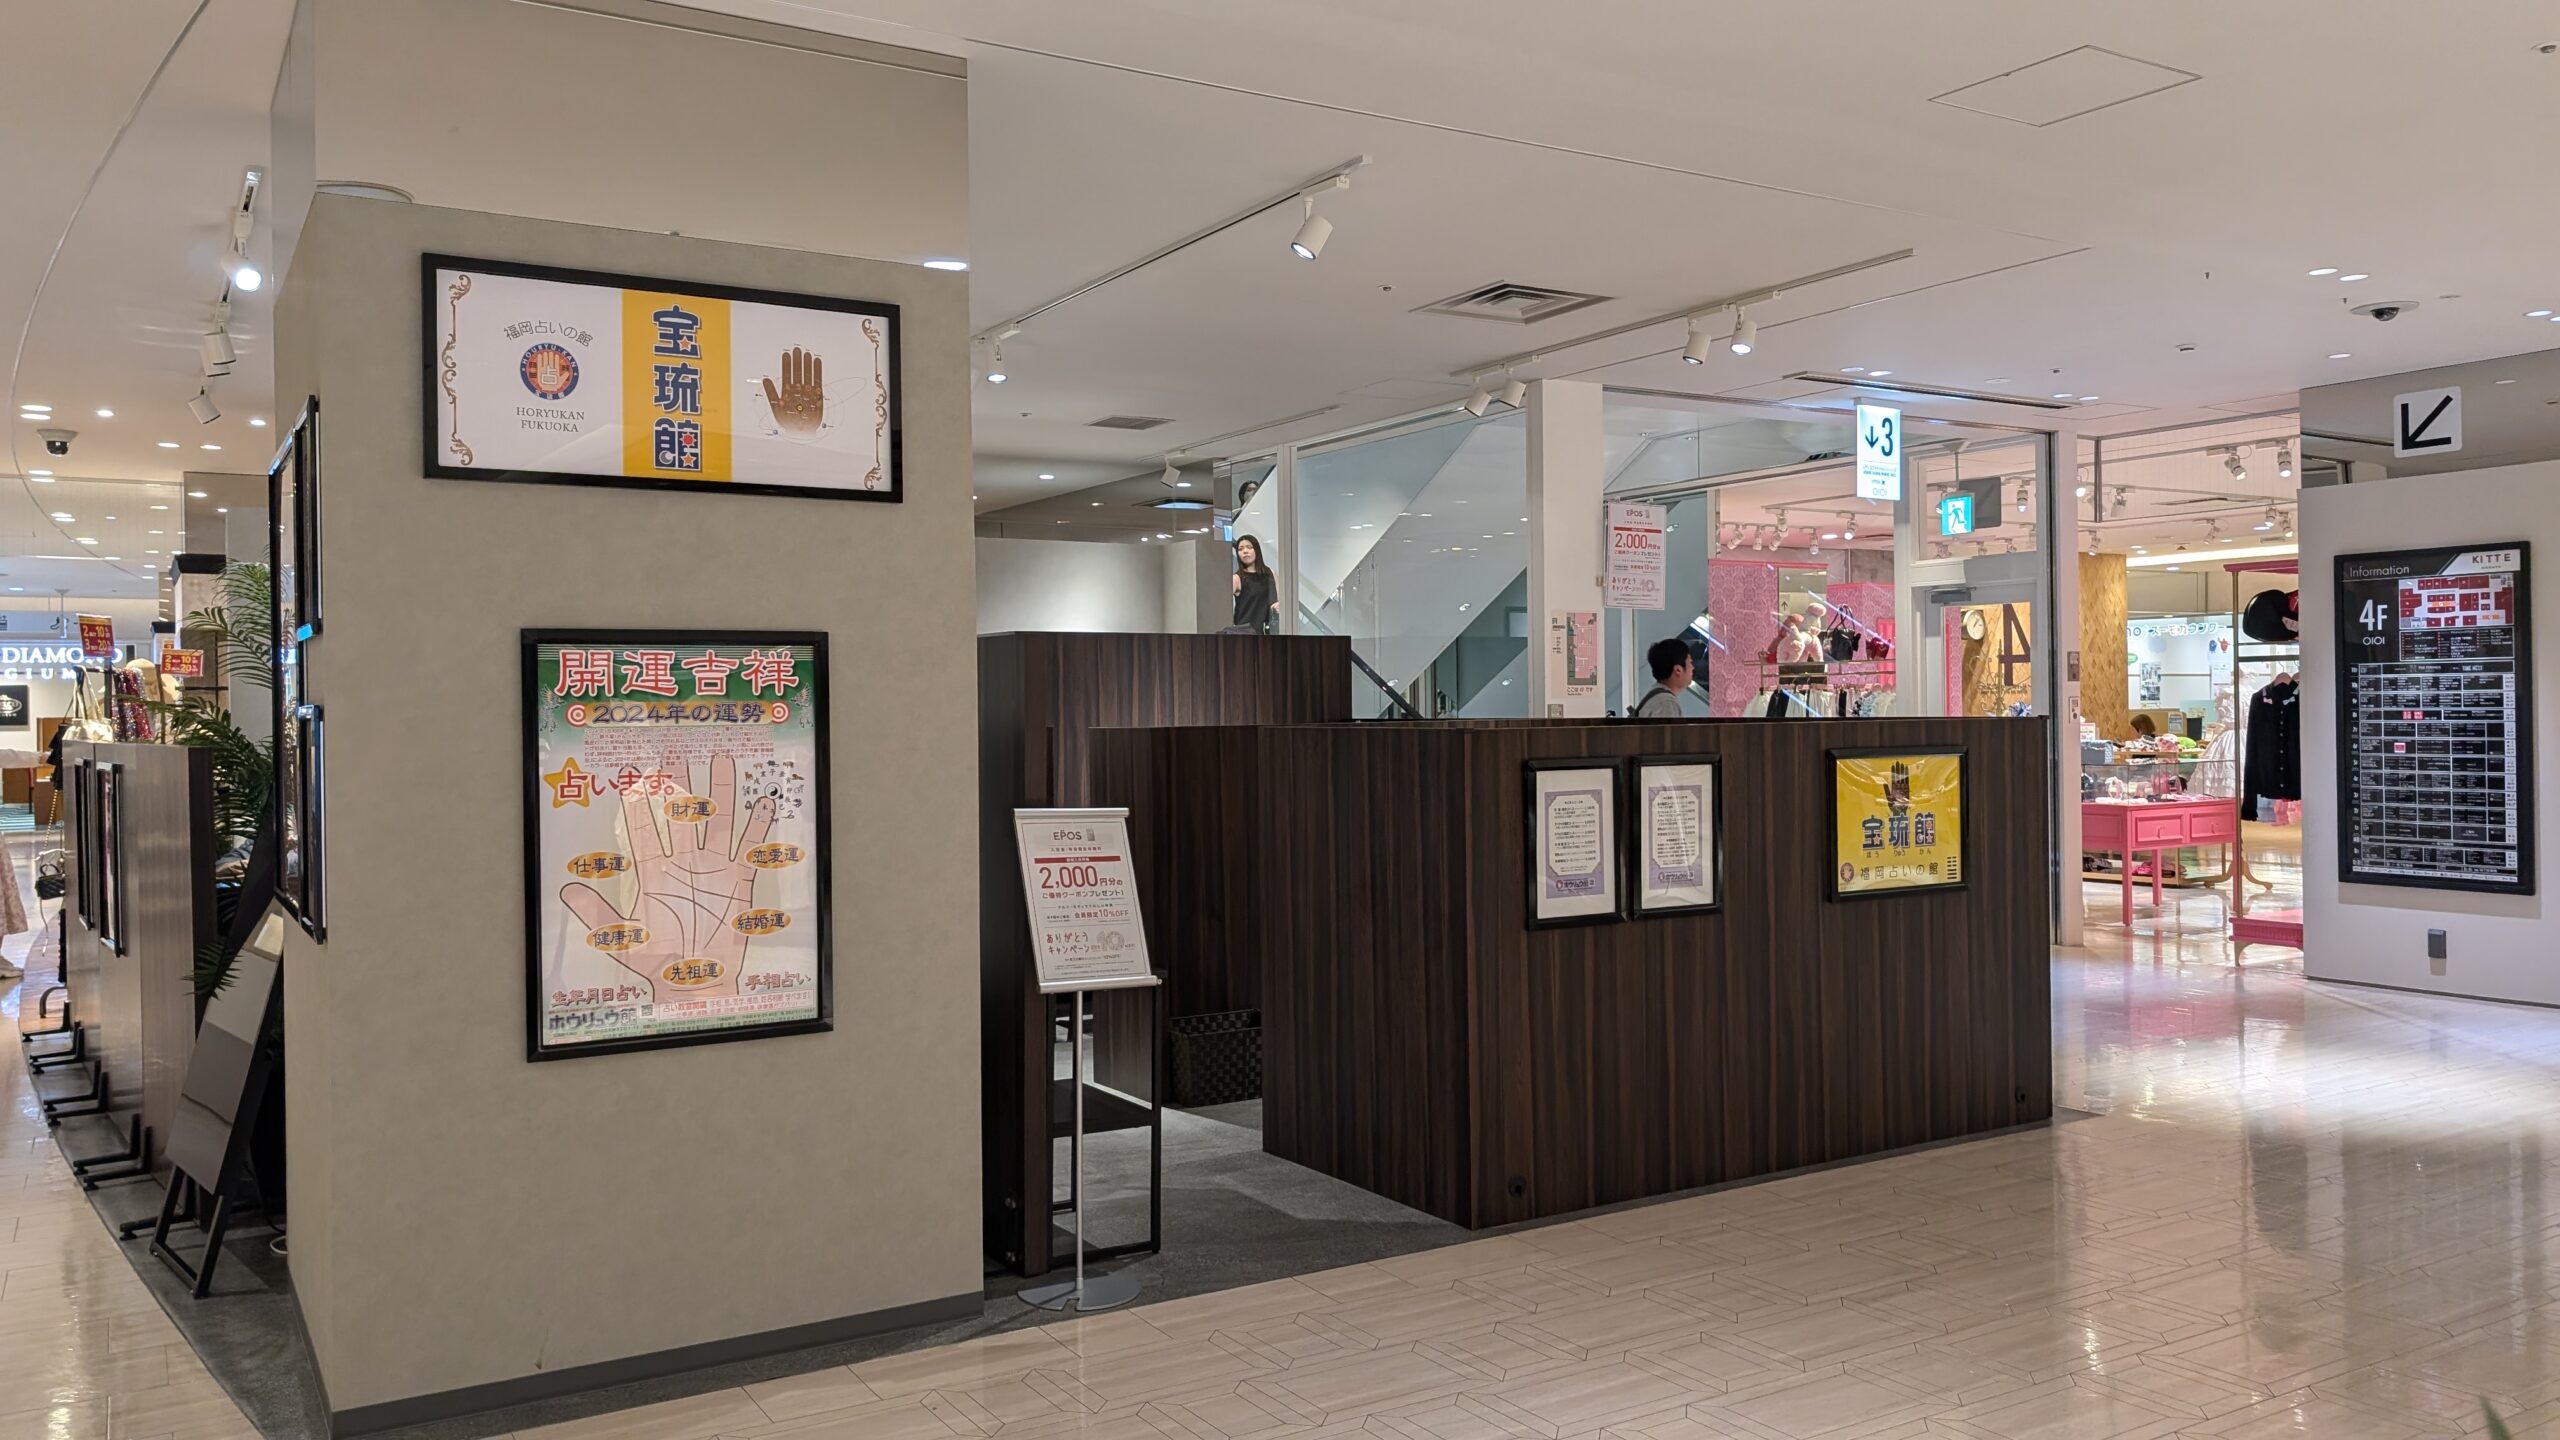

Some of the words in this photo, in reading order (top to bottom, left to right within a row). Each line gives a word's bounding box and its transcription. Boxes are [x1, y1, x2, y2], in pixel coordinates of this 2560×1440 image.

[504, 320, 594, 347] 福岡占いの館
[651, 303, 703, 473] 宝琉館
[516, 406, 585, 420] HORYUKAN
[521, 419, 579, 433] FUKUOKA
[1881, 417, 1894, 457] 3
[1626, 509, 1643, 518] EPOS
[2472, 553, 2511, 564] KITTE
[2350, 565, 2410, 578] Information
[2359, 599, 2388, 631] 4F
[82, 625, 89, 637] 2
[96, 624, 105, 637] 10
[84, 639, 91, 651] 3
[180, 664, 192, 672] 20
[554, 649, 799, 697] 開運吉祥
[592, 702, 765, 725] 2024年の運勢
[671, 801, 710, 817] 財運
[1053, 829, 1082, 841] EPOS
[1862, 812, 1936, 850] 宝琉館
[573, 856, 625, 874] 仕事運
[752, 847, 799, 865] 恋愛運
[1039, 864, 1123, 889] 2,000円分の
[1860, 862, 1939, 880] 福岡占いの館
[737, 913, 785, 930] 結婚運
[592, 927, 644, 946] 健康運
[1046, 931, 1088, 944] ありがとう
[1048, 944, 1090, 955] キャンペーン
[670, 962, 719, 980] 先祖運
[745, 970, 811, 991] 手相占い
[551, 984, 648, 1008] 生年月日占い
